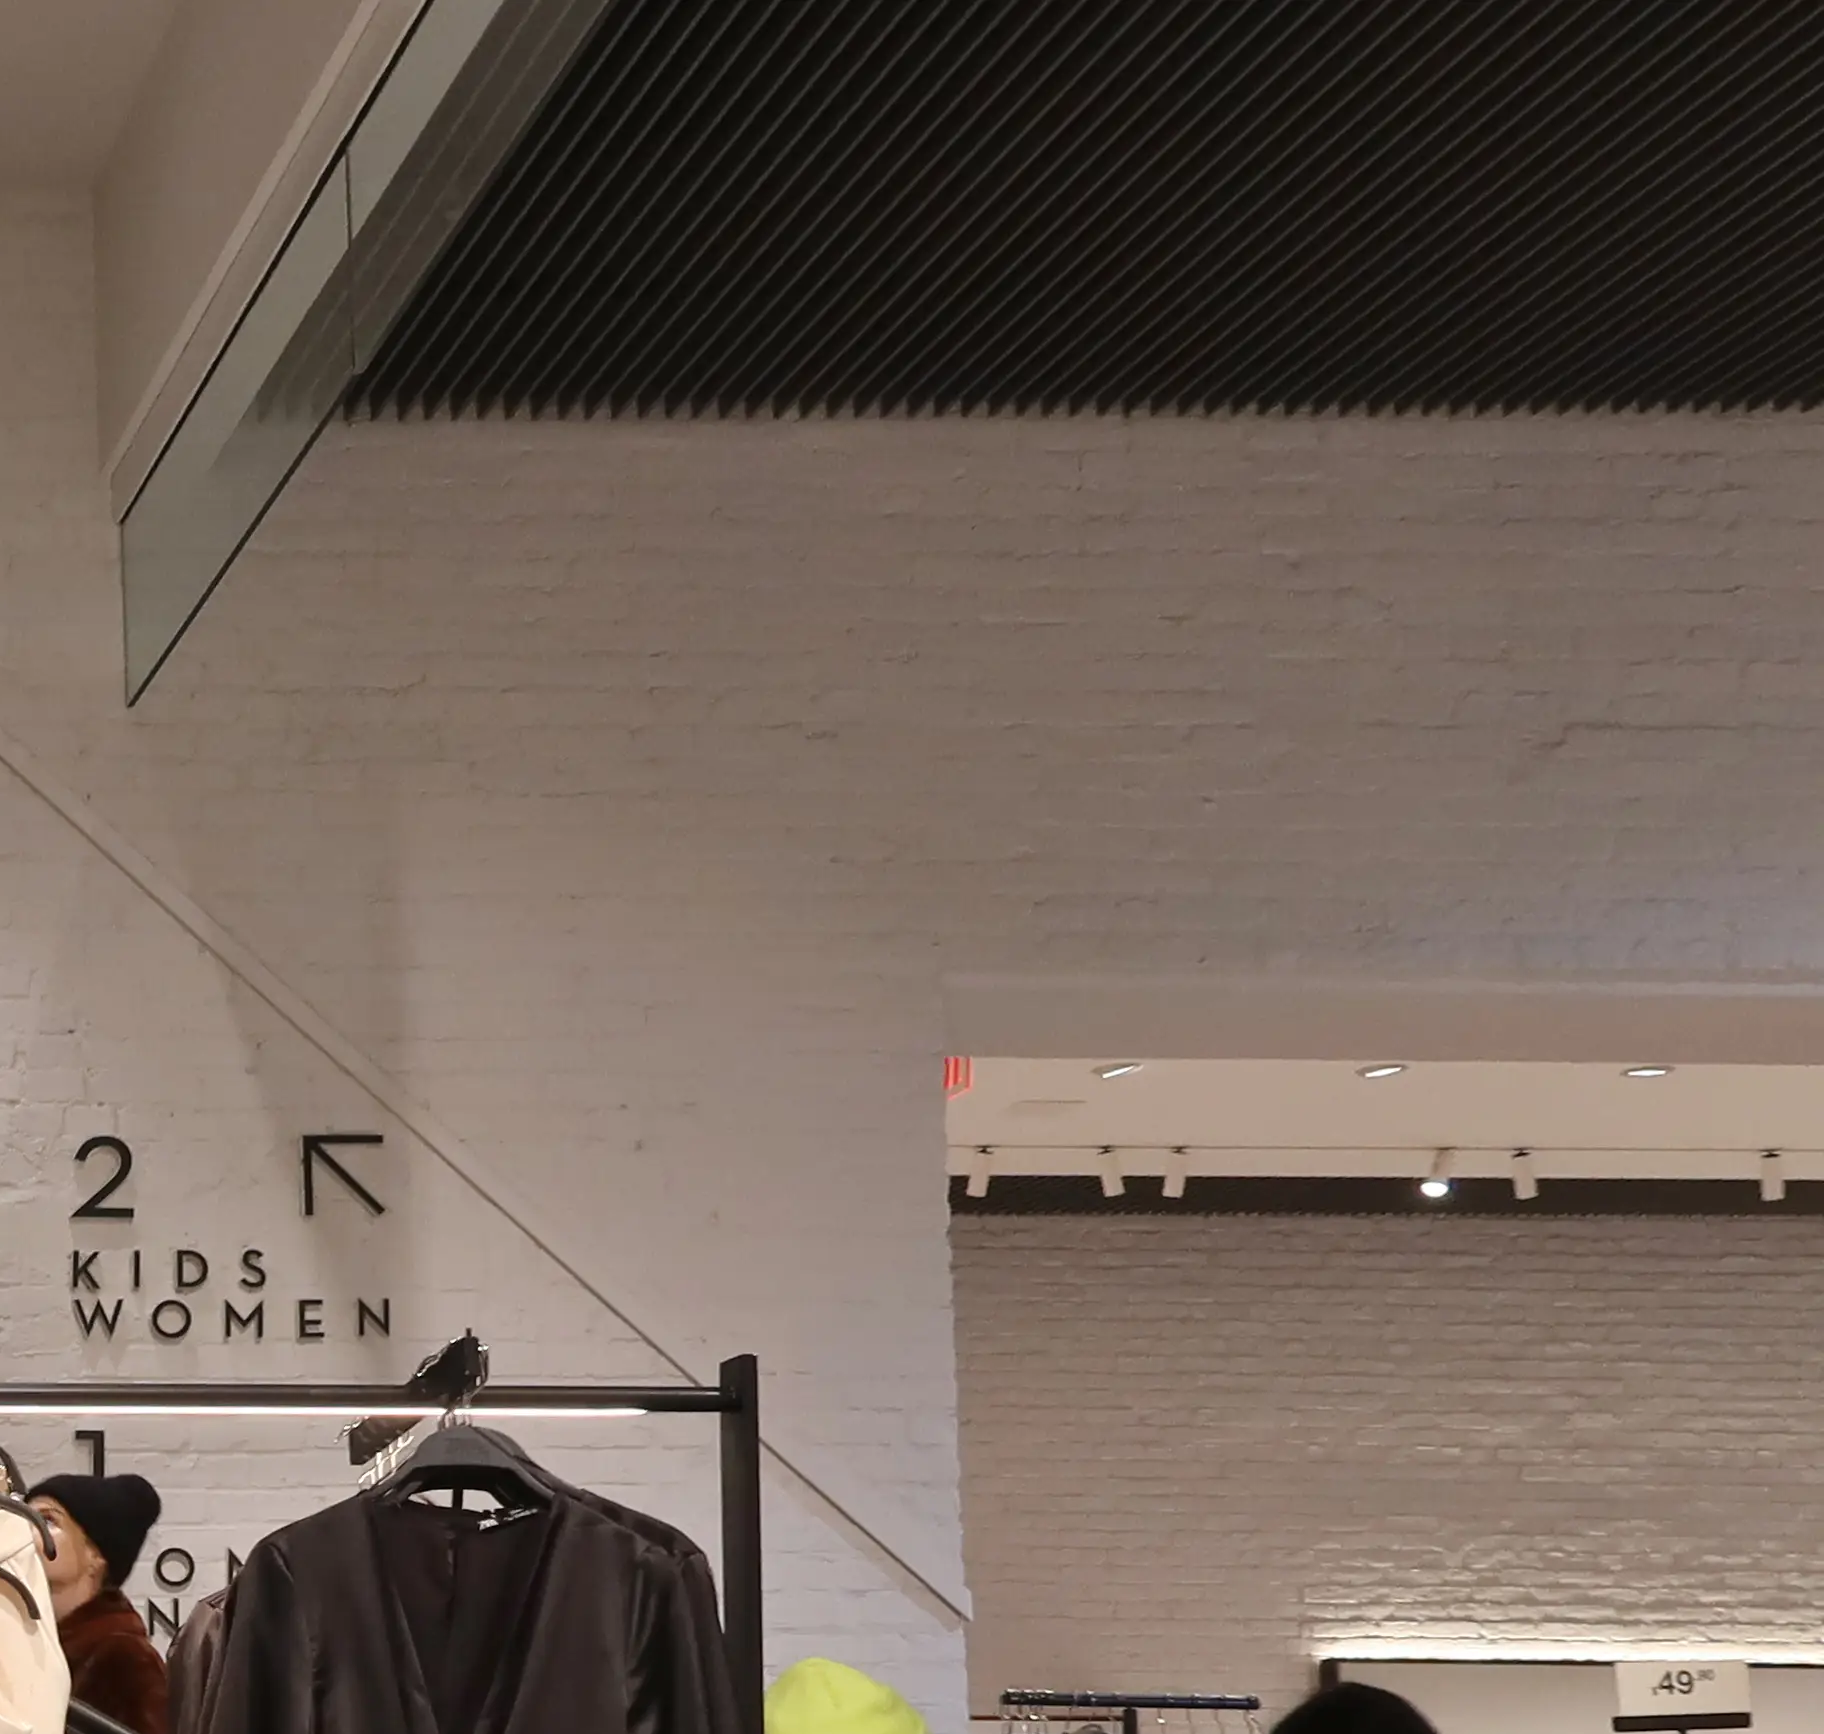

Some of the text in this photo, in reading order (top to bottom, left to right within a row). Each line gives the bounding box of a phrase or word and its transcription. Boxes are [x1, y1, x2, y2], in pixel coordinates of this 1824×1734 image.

[70, 1136, 135, 1218] 2
[72, 1250, 267, 1290] KIDS
[73, 1298, 390, 1338] WOMEN
